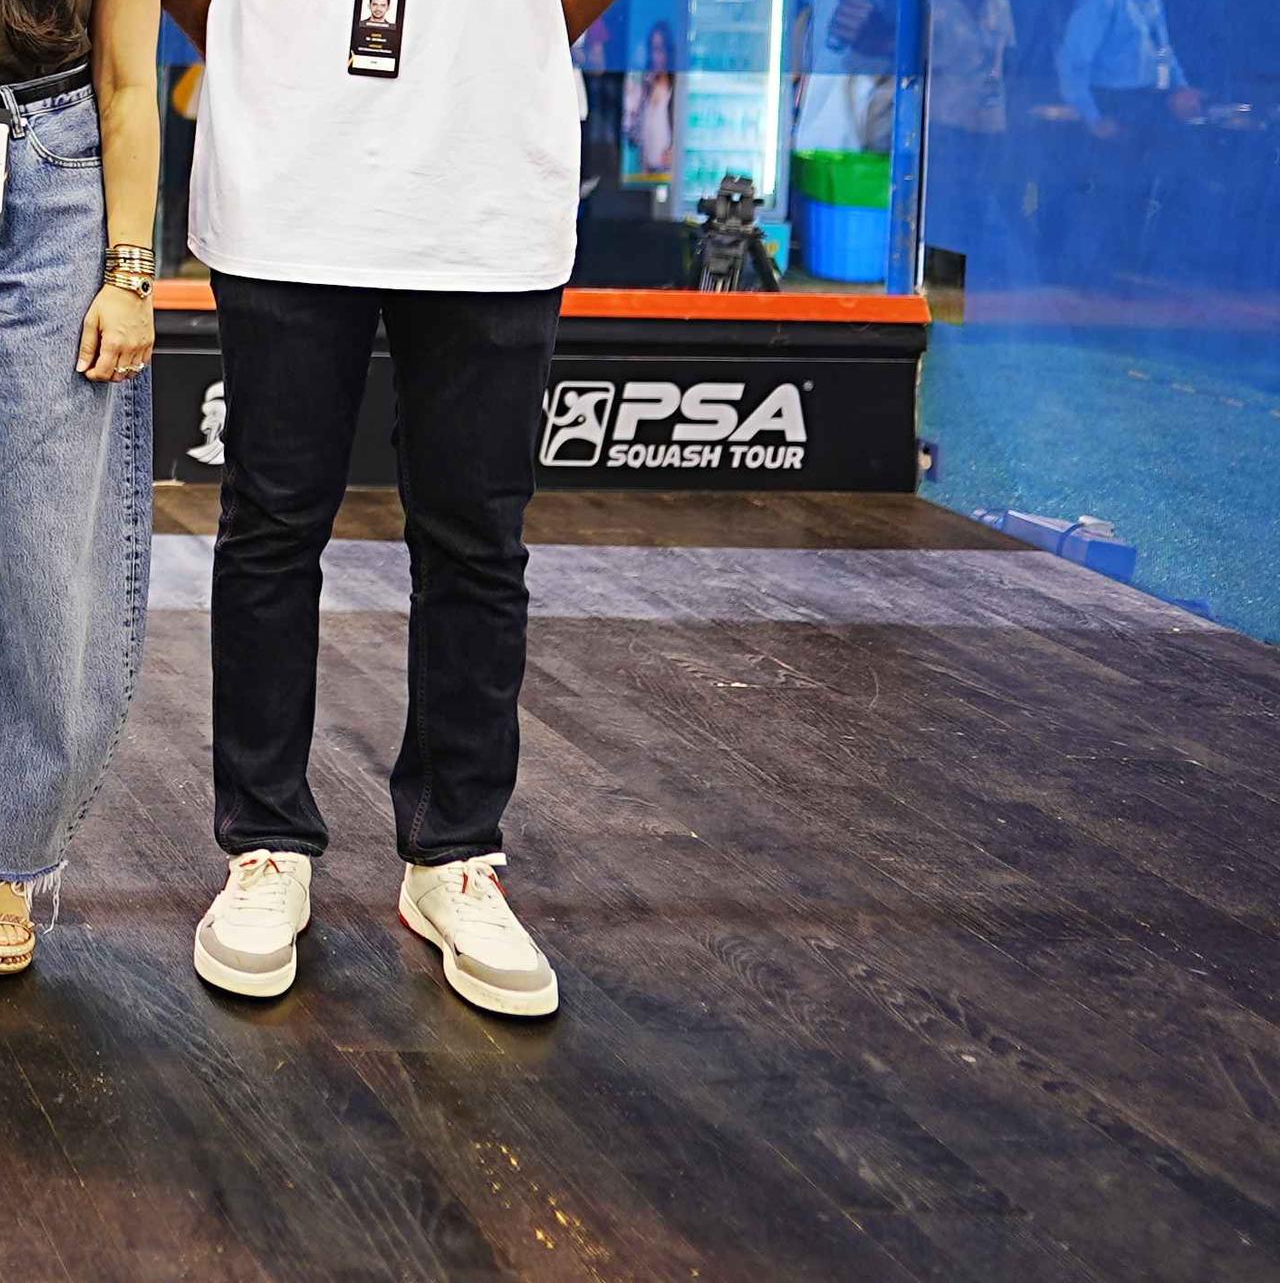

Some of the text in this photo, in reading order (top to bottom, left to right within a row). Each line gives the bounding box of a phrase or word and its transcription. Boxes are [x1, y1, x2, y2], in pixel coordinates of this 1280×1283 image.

[612, 381, 807, 442] PSA
[606, 444, 804, 469] SQUASH TOUR
